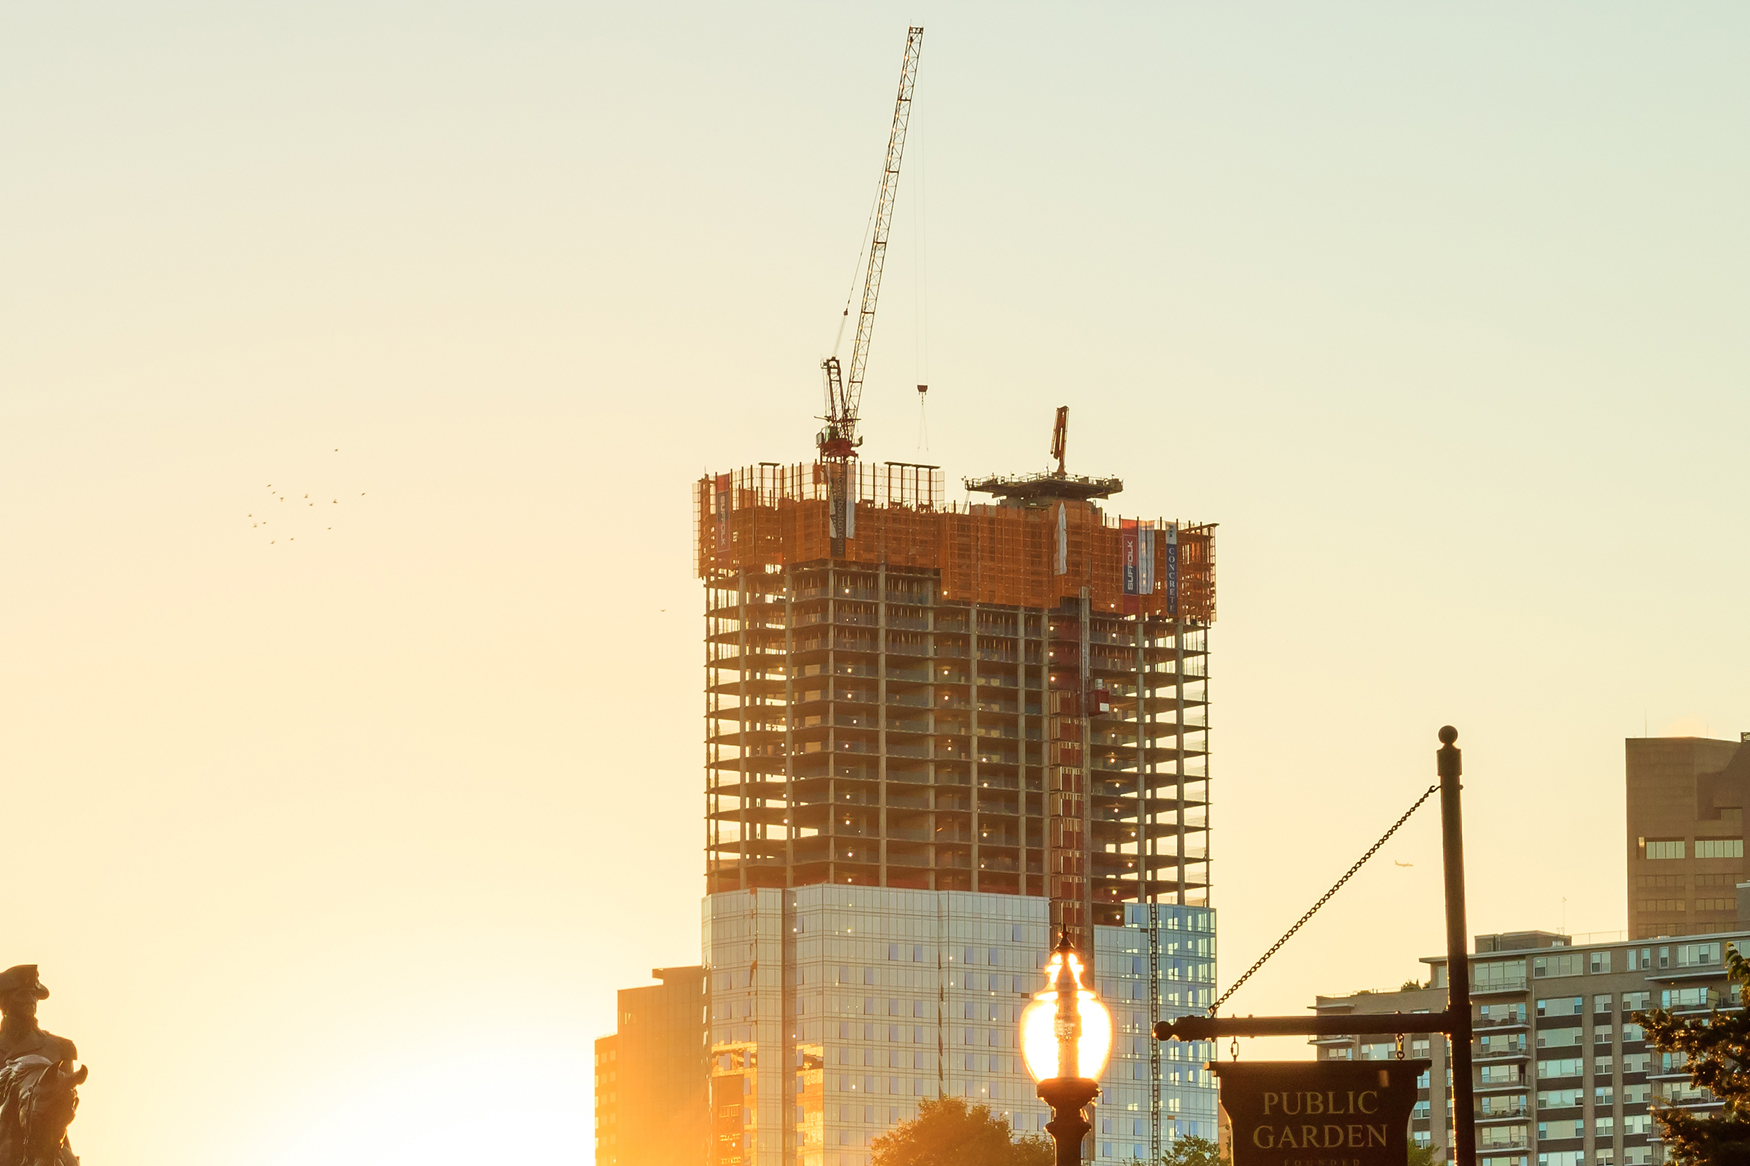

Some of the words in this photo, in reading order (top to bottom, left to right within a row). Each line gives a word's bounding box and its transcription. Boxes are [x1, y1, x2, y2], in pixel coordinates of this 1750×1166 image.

[1262, 1090, 1379, 1115] PUBLIC
[1253, 1124, 1388, 1149] GARDEN
[1284, 1159, 1360, 1166] FOUNDED
